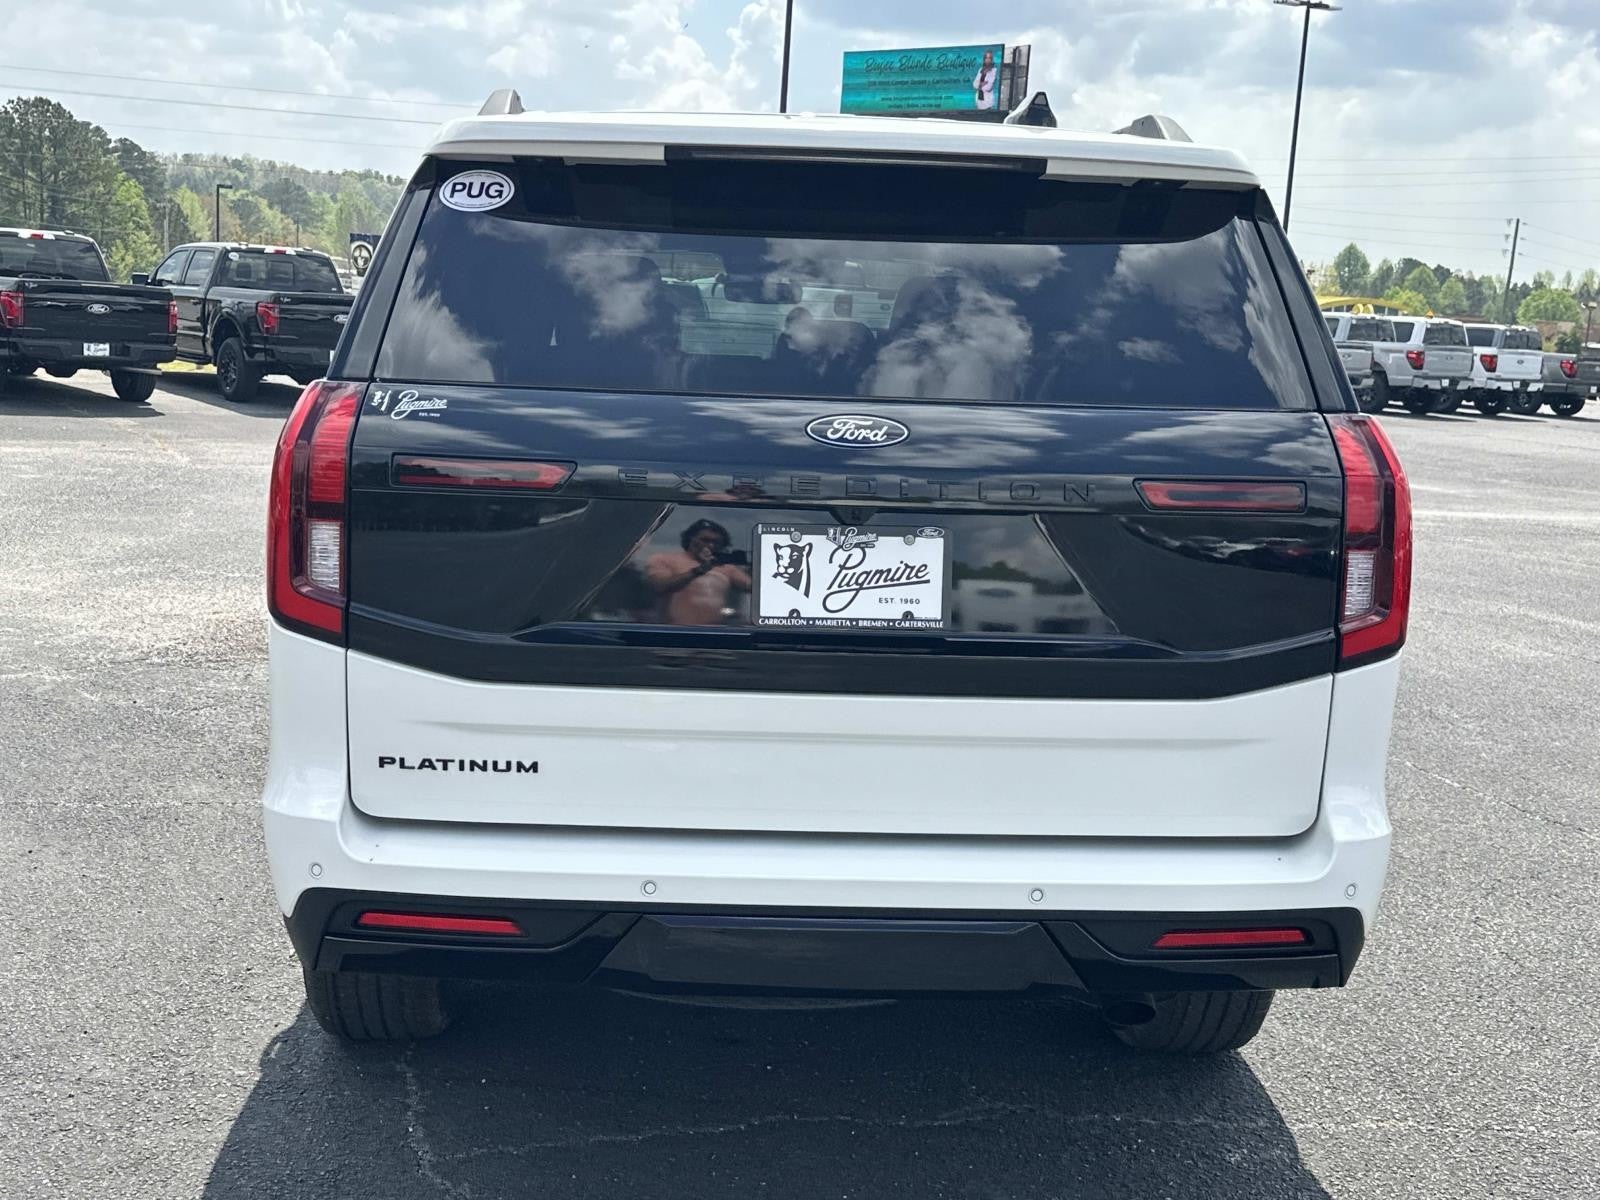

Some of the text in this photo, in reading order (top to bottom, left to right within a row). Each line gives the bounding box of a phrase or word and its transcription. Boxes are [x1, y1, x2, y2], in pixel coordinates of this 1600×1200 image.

[898, 54, 931, 72] Blonde
[935, 53, 977, 71] Boutique
[449, 181, 504, 199] PUG
[390, 389, 448, 420] Pugmire
[826, 418, 889, 442] Ford
[617, 468, 1097, 503] EXPEDITION
[842, 527, 878, 551] Pugmire
[921, 527, 940, 537] Ford
[822, 546, 931, 613] Pugmire
[878, 597, 921, 605] EST. 1960
[758, 617, 944, 629] CARROLLTON MARIETTA BREMEN CARTERSVILLE
[378, 756, 539, 774] PLATINUM
